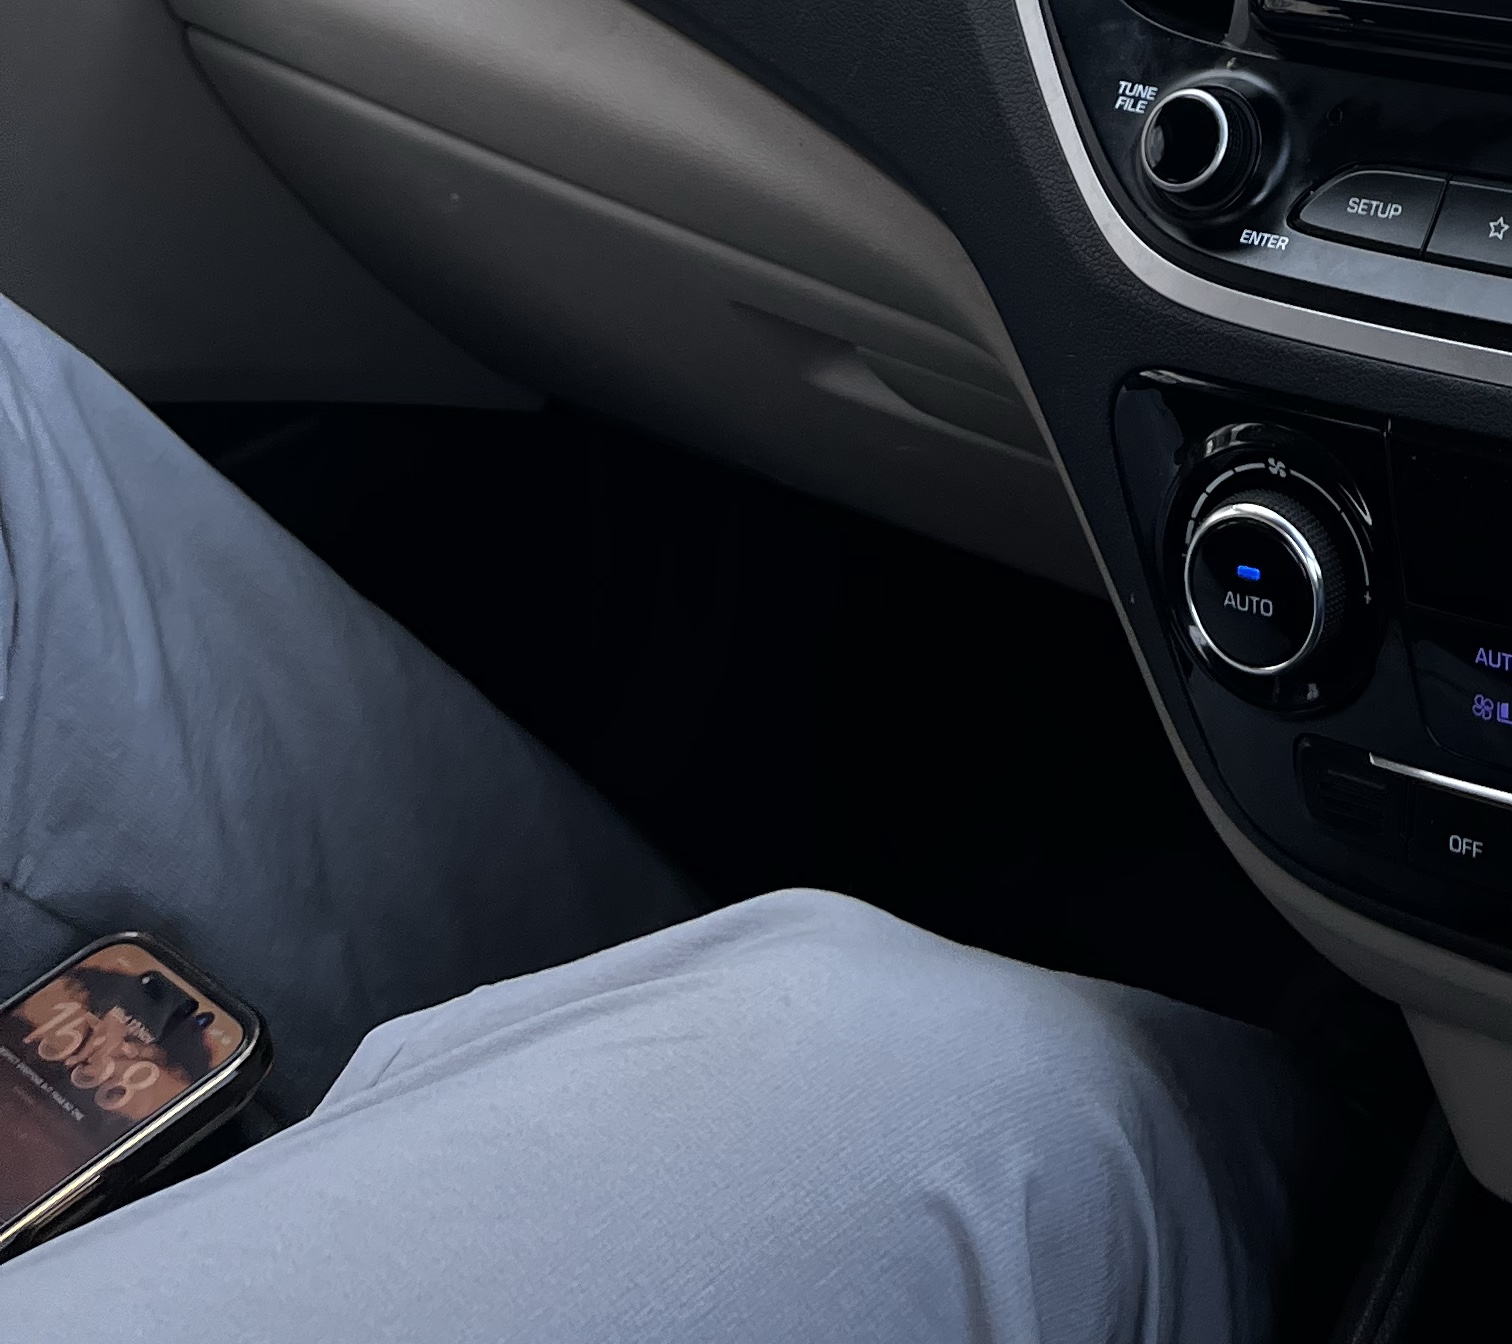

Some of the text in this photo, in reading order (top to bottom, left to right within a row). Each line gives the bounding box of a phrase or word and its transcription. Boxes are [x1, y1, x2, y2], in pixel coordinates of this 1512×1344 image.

[1117, 80, 1158, 102] TUNE
[1115, 95, 1147, 115] FILE
[1346, 196, 1403, 221] SETUP
[1239, 228, 1290, 251] ENTER
[1223, 590, 1274, 618] AUTO
[1449, 833, 1484, 860] OFF
